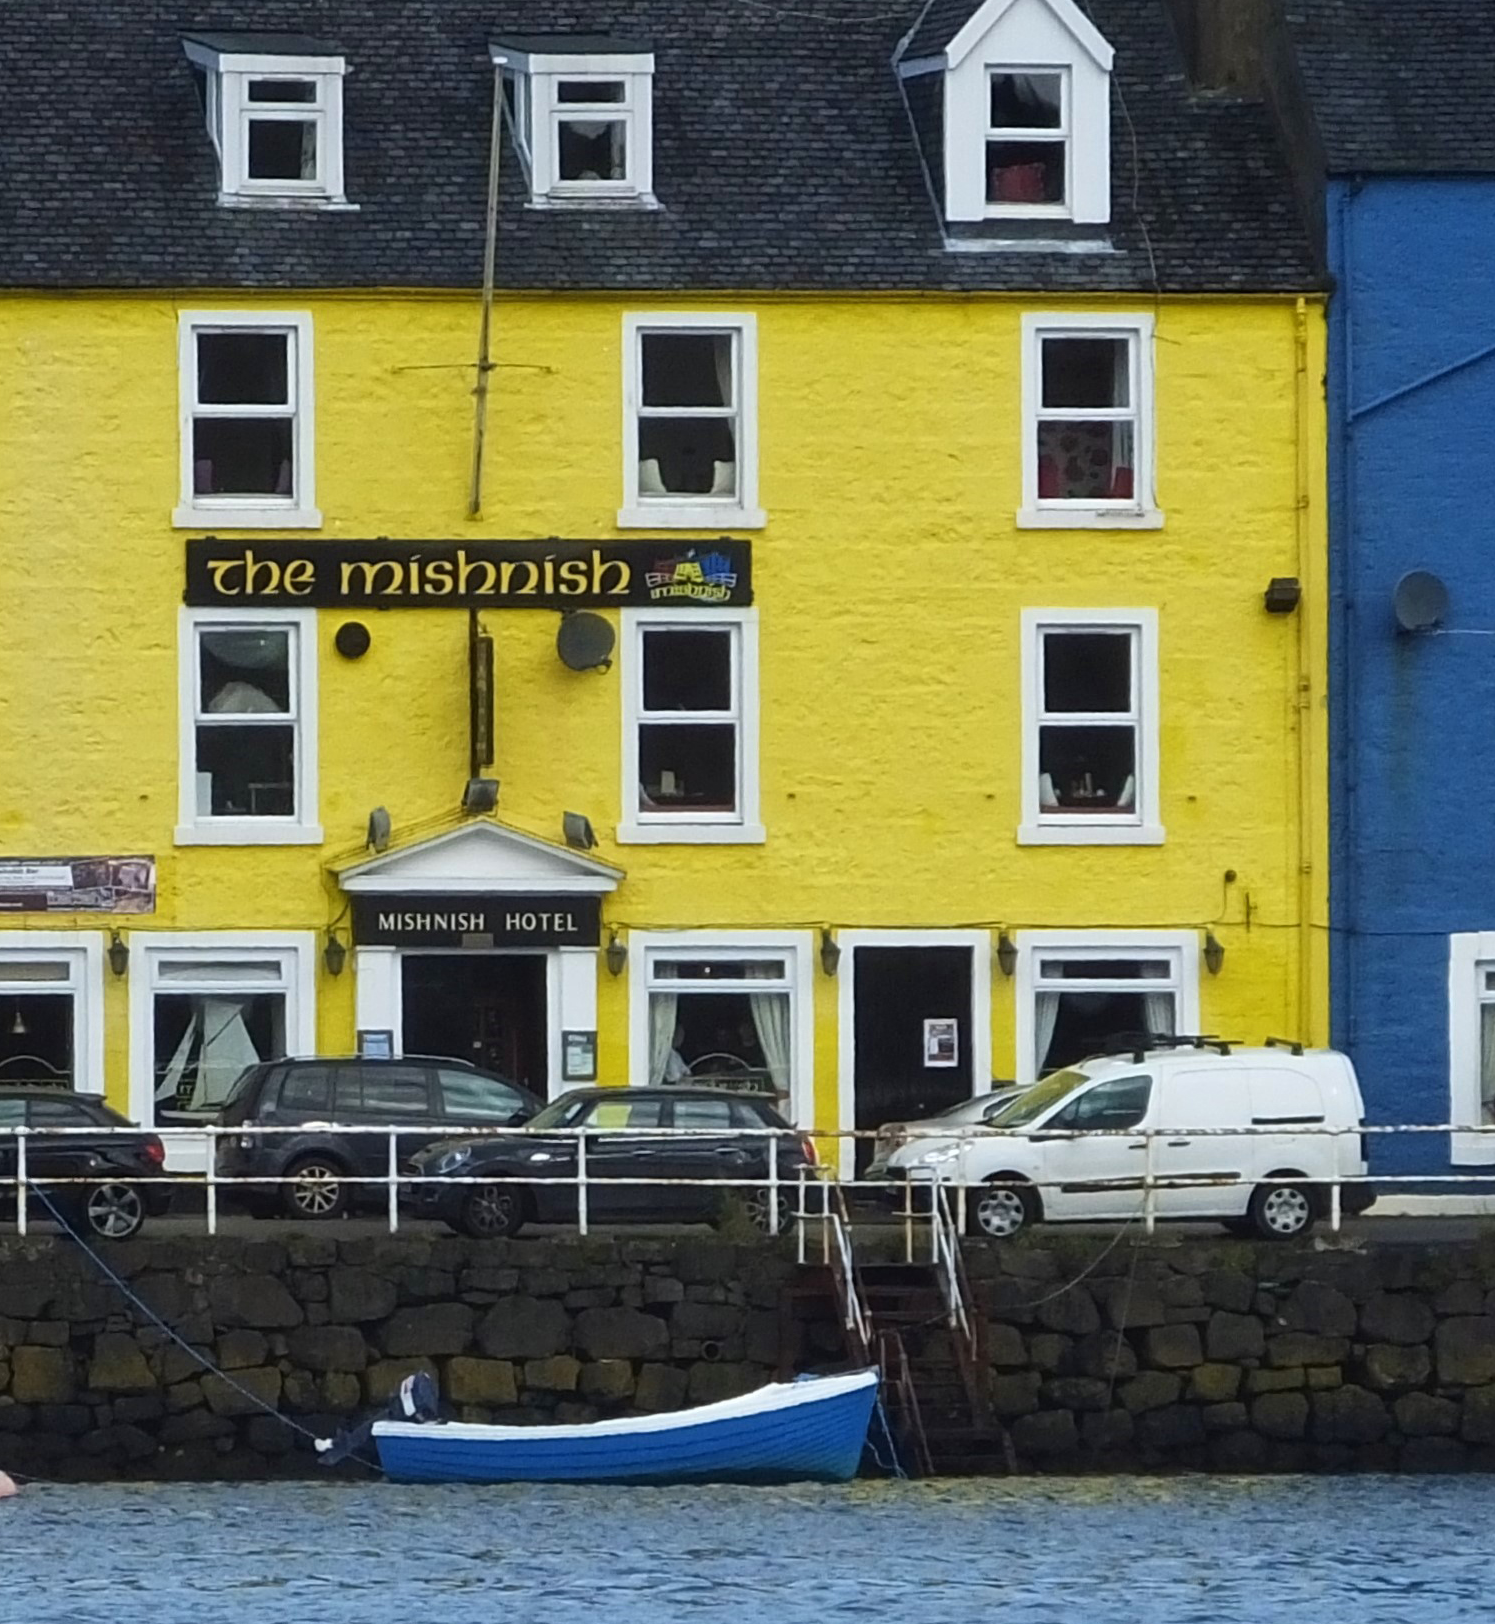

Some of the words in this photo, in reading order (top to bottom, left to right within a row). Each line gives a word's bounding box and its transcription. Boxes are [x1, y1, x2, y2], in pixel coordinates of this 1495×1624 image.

[207, 549, 316, 596] the
[340, 549, 631, 595] mishnish
[378, 913, 485, 931] MISHNISH
[505, 913, 578, 931] HOTEL
